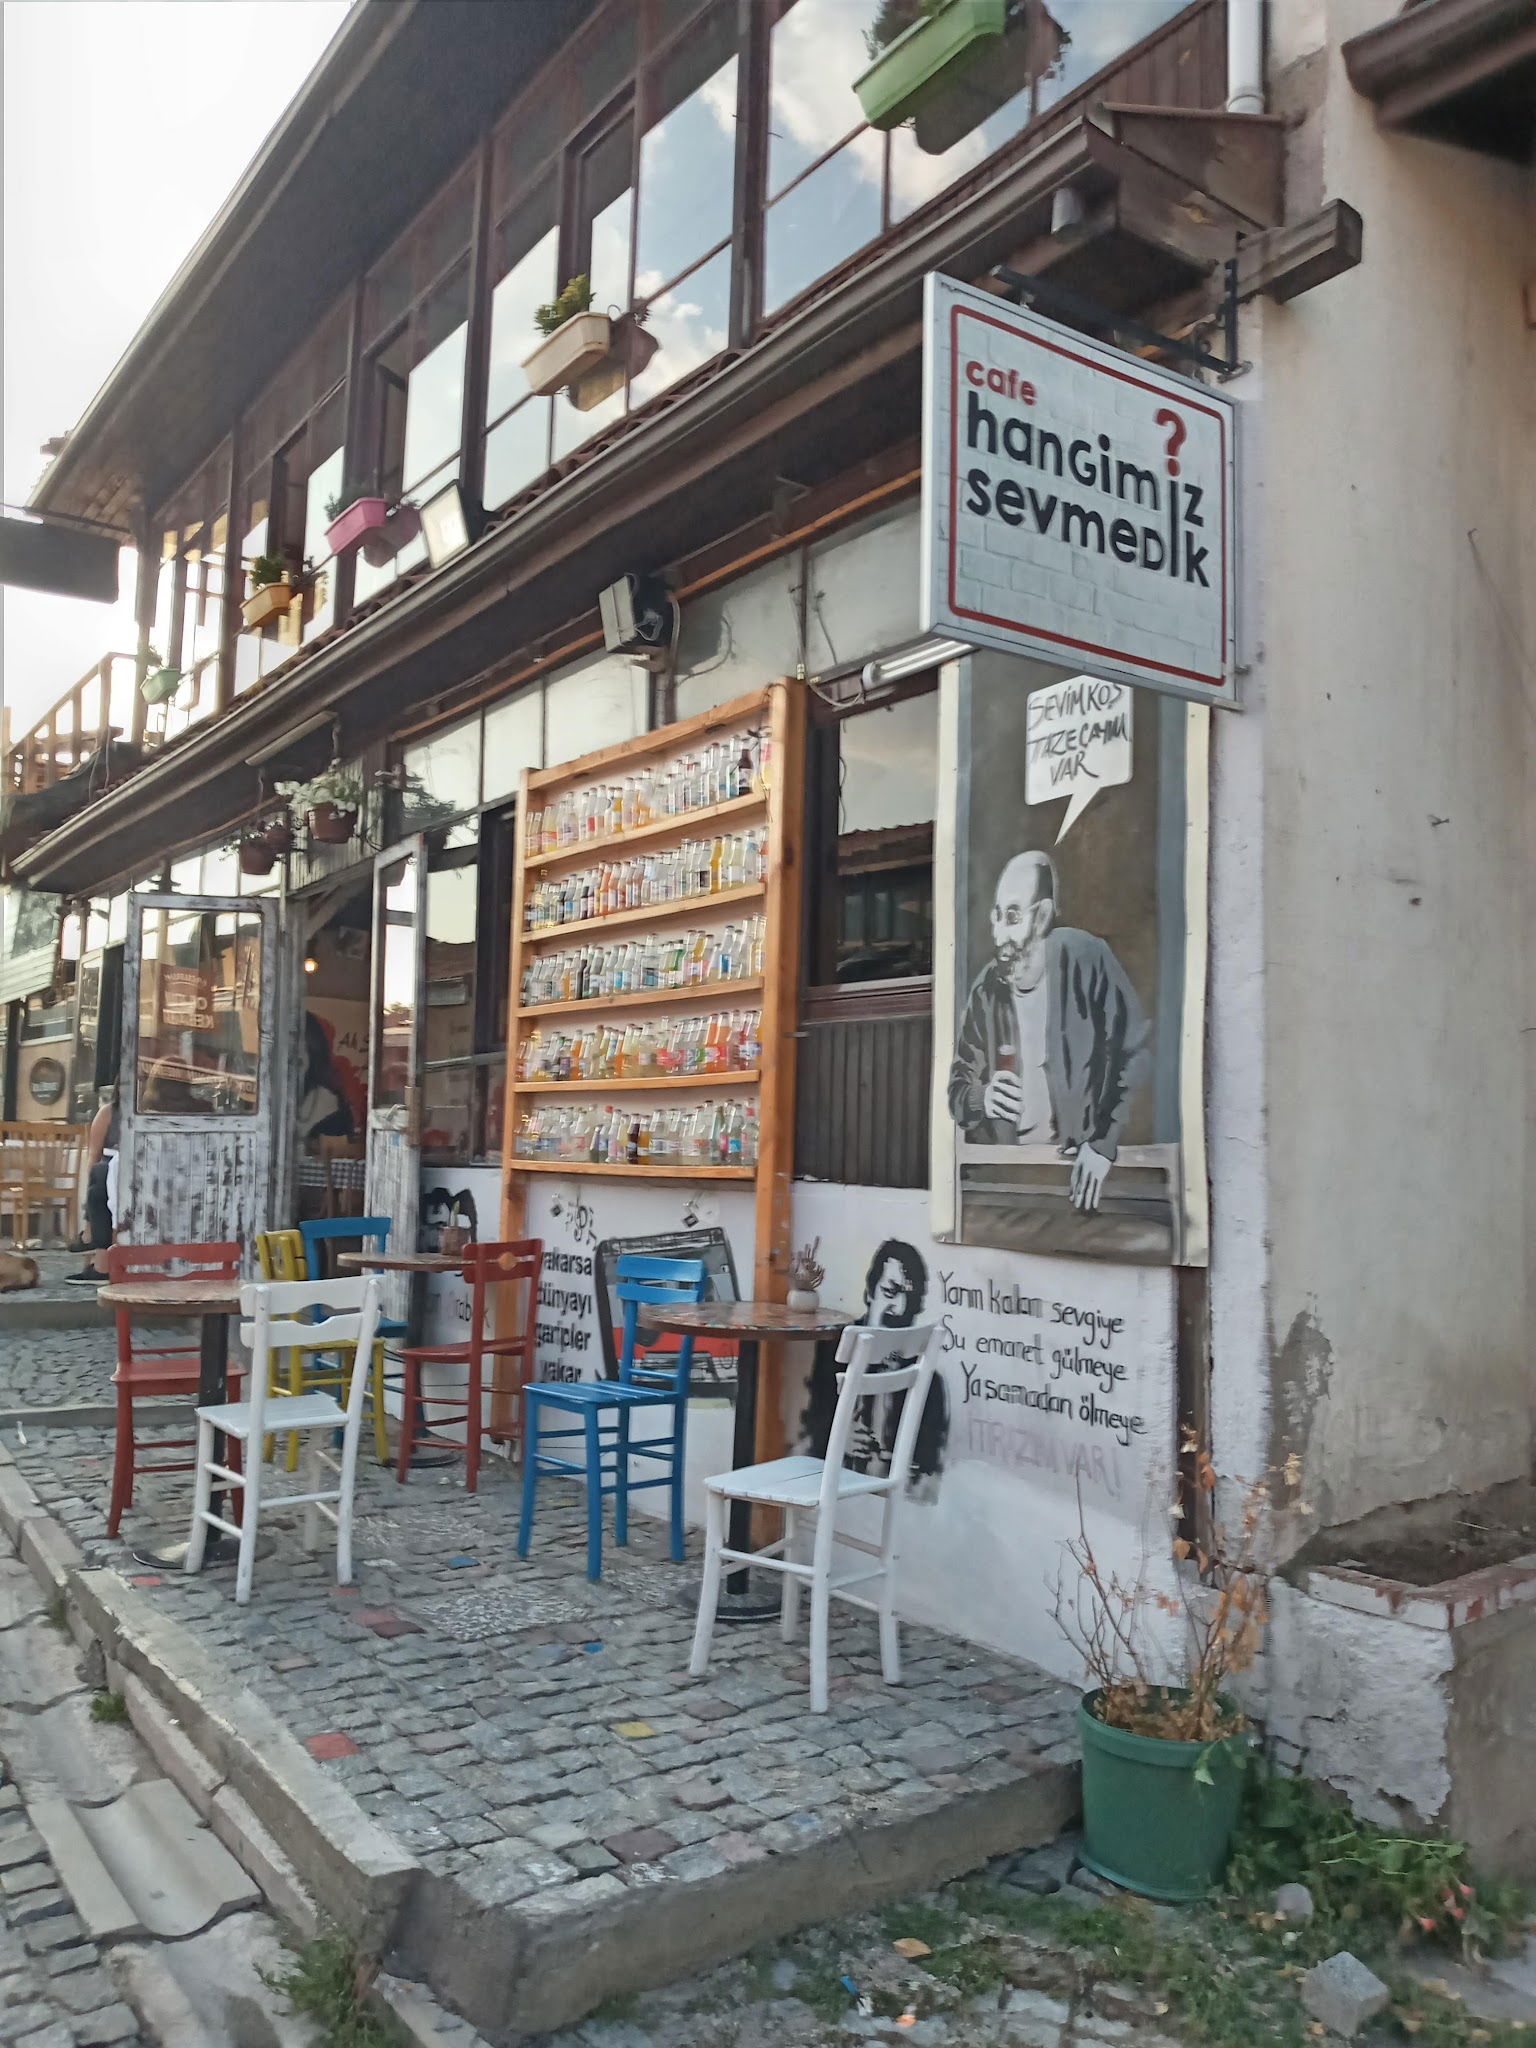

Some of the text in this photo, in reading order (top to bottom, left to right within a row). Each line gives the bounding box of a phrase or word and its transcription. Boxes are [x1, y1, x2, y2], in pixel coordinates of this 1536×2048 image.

[965, 359, 1037, 406] cafe
[1050, 750, 1100, 787] VAR
[541, 1245, 593, 1277] akarsa
[1049, 1300, 1126, 1350] sevgiye
[975, 1332, 1046, 1366] emanet
[1049, 1344, 1130, 1394] gülmeye
[1077, 1391, 1149, 1448] ölmeye
